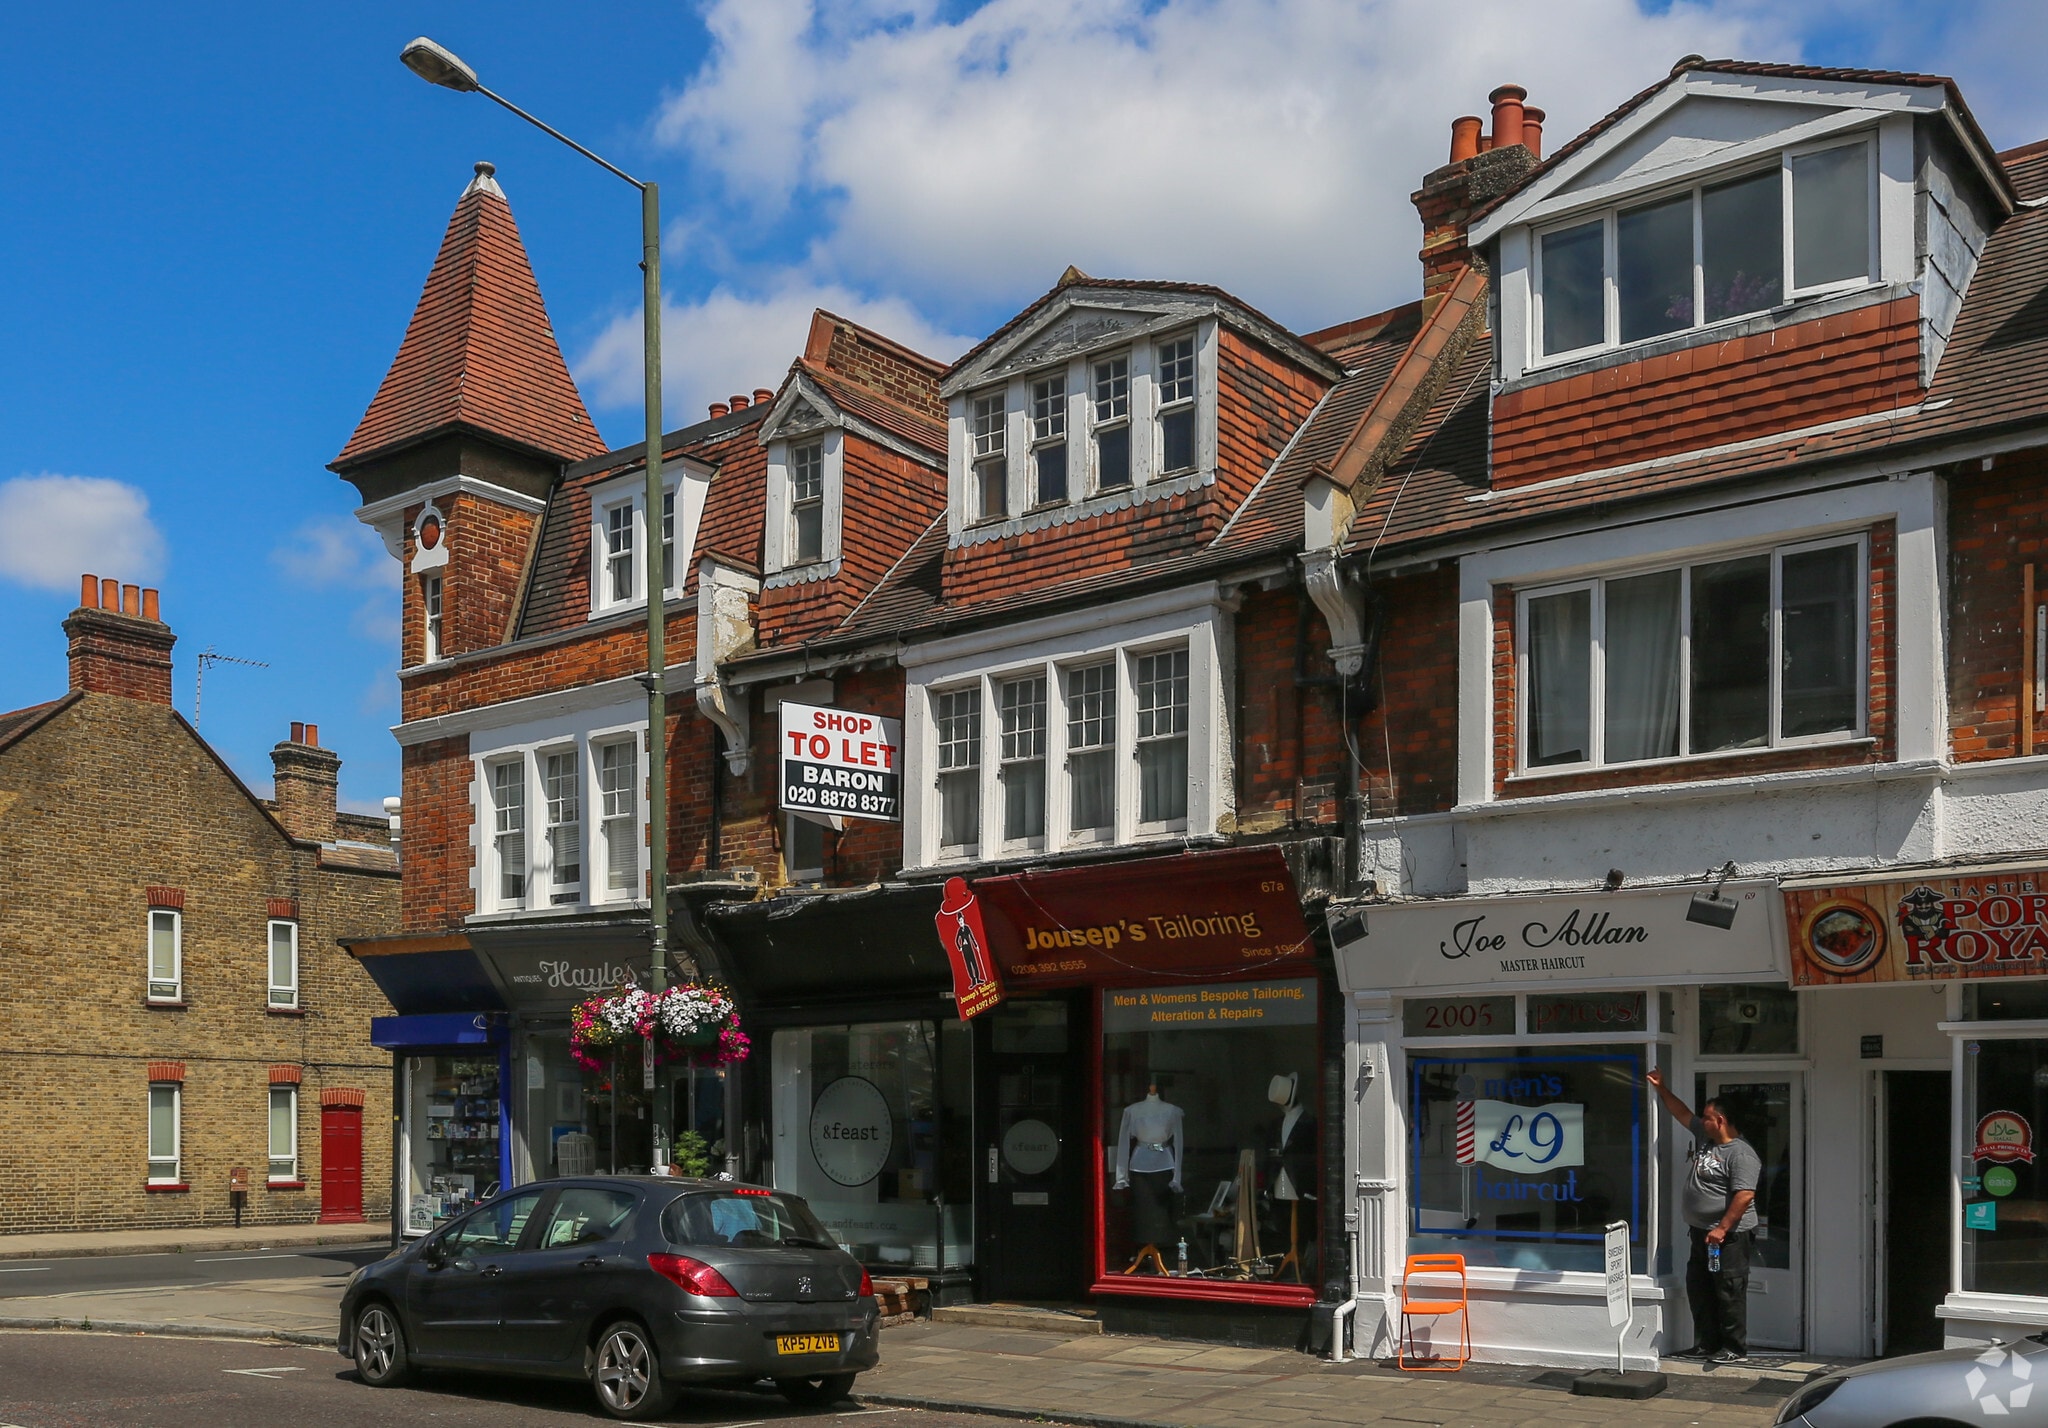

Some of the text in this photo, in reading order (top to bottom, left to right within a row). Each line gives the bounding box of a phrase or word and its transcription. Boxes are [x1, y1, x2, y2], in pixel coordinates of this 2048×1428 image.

[813, 711, 872, 735] SHOP
[787, 731, 897, 769] TO LET
[803, 765, 883, 792] BARON
[788, 785, 896, 814] 020 8878 8377
[1261, 881, 1285, 893] 67a
[1949, 881, 2034, 897] TASTE
[1026, 911, 1262, 951] Jousep's Tailoring
[1440, 909, 1649, 960] Joe Allan
[1241, 947, 1272, 958] Since
[1011, 960, 1087, 975] 0208 392 6555
[1500, 956, 1585, 972] MASTER HAIRCUT
[513, 974, 543, 984] ANTIQUES
[1113, 986, 1305, 1007] Men & Womens Bespoke Tailoring,
[1151, 1007, 1264, 1022] Alteration & Repairs
[1425, 992, 1642, 1032] 2005 prices!
[1484, 1073, 1563, 1097] men's
[823, 1122, 879, 1141] &feast
[1489, 1111, 1564, 1164] £9
[1987, 1121, 2019, 1137] حلال
[1477, 1168, 1585, 1203] haircut
[1988, 1178, 2012, 1187] eats
[1610, 1258, 1622, 1271] SPORT
[783, 1336, 811, 1352] KP57
